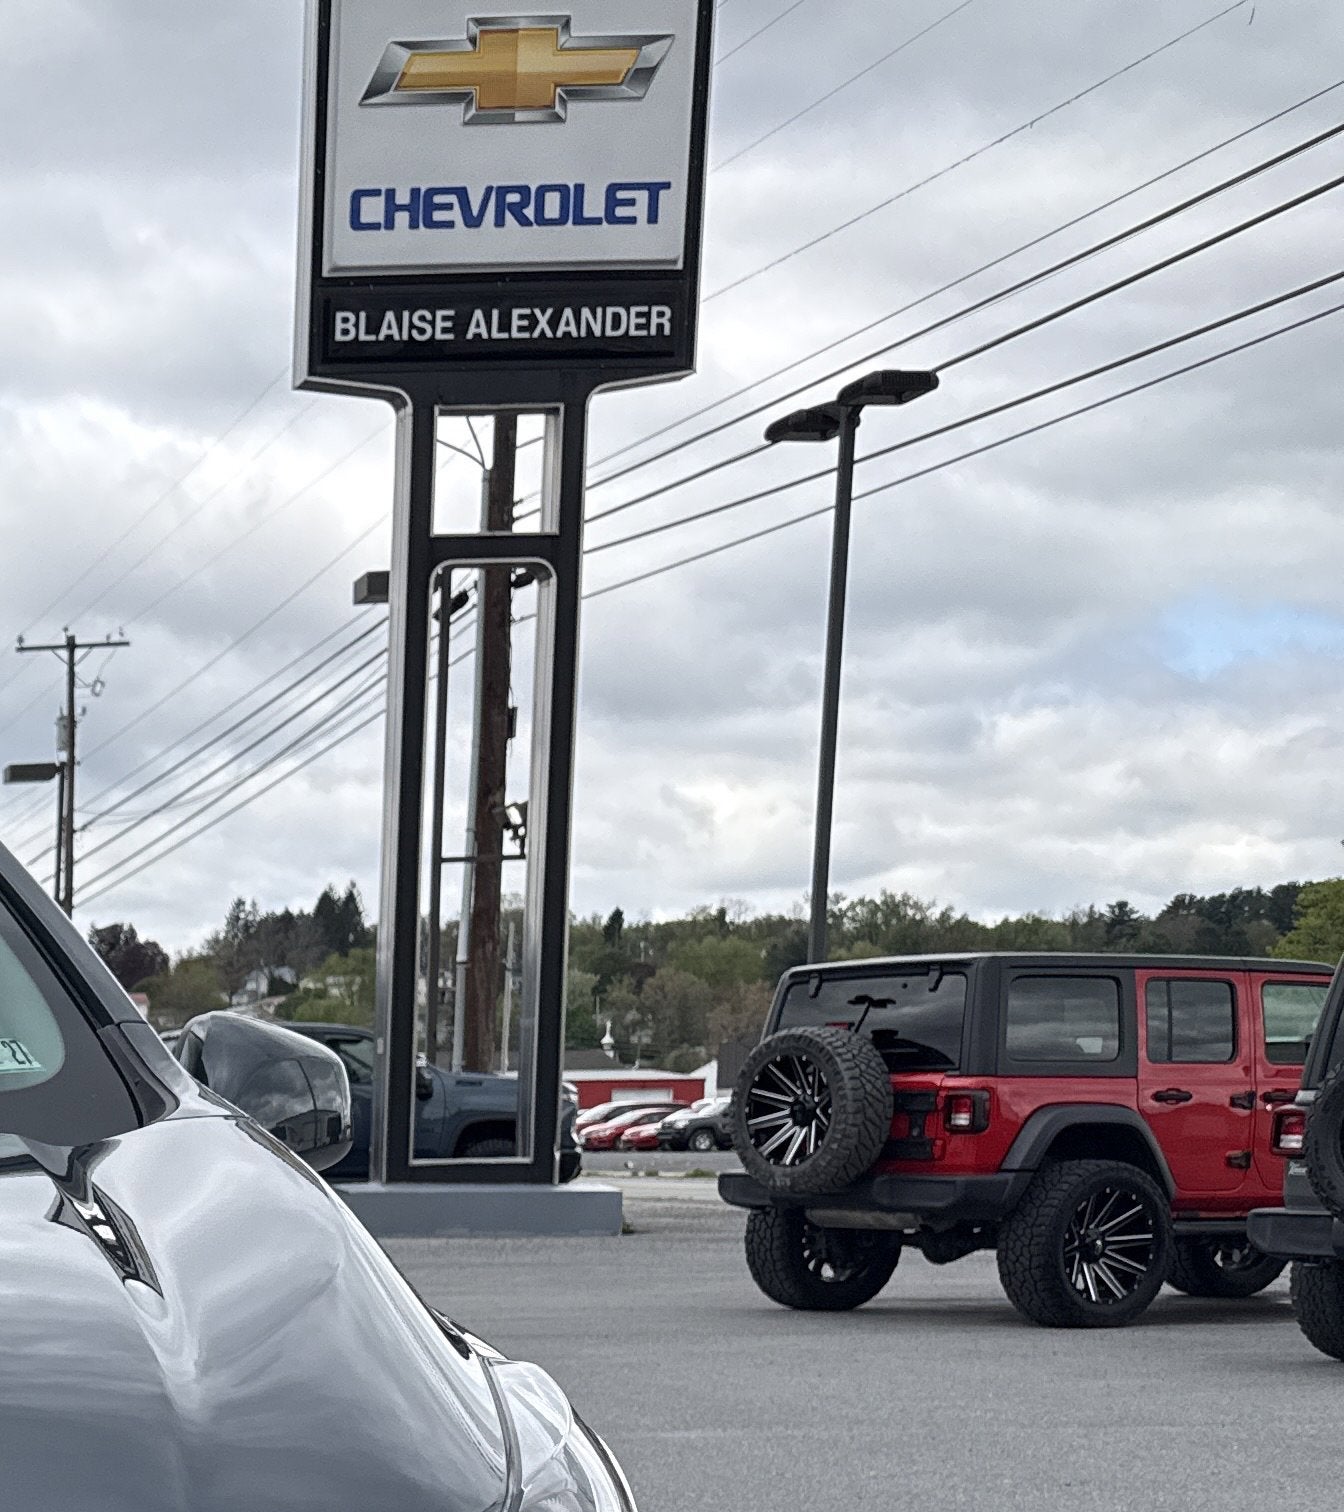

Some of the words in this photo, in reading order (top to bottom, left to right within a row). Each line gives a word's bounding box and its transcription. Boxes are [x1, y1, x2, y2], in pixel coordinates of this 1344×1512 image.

[349, 181, 672, 231] CHEVROLET
[333, 308, 456, 343] BLAISE
[465, 305, 672, 341] ALEXANDER
[0, 1039, 34, 1067] 27
